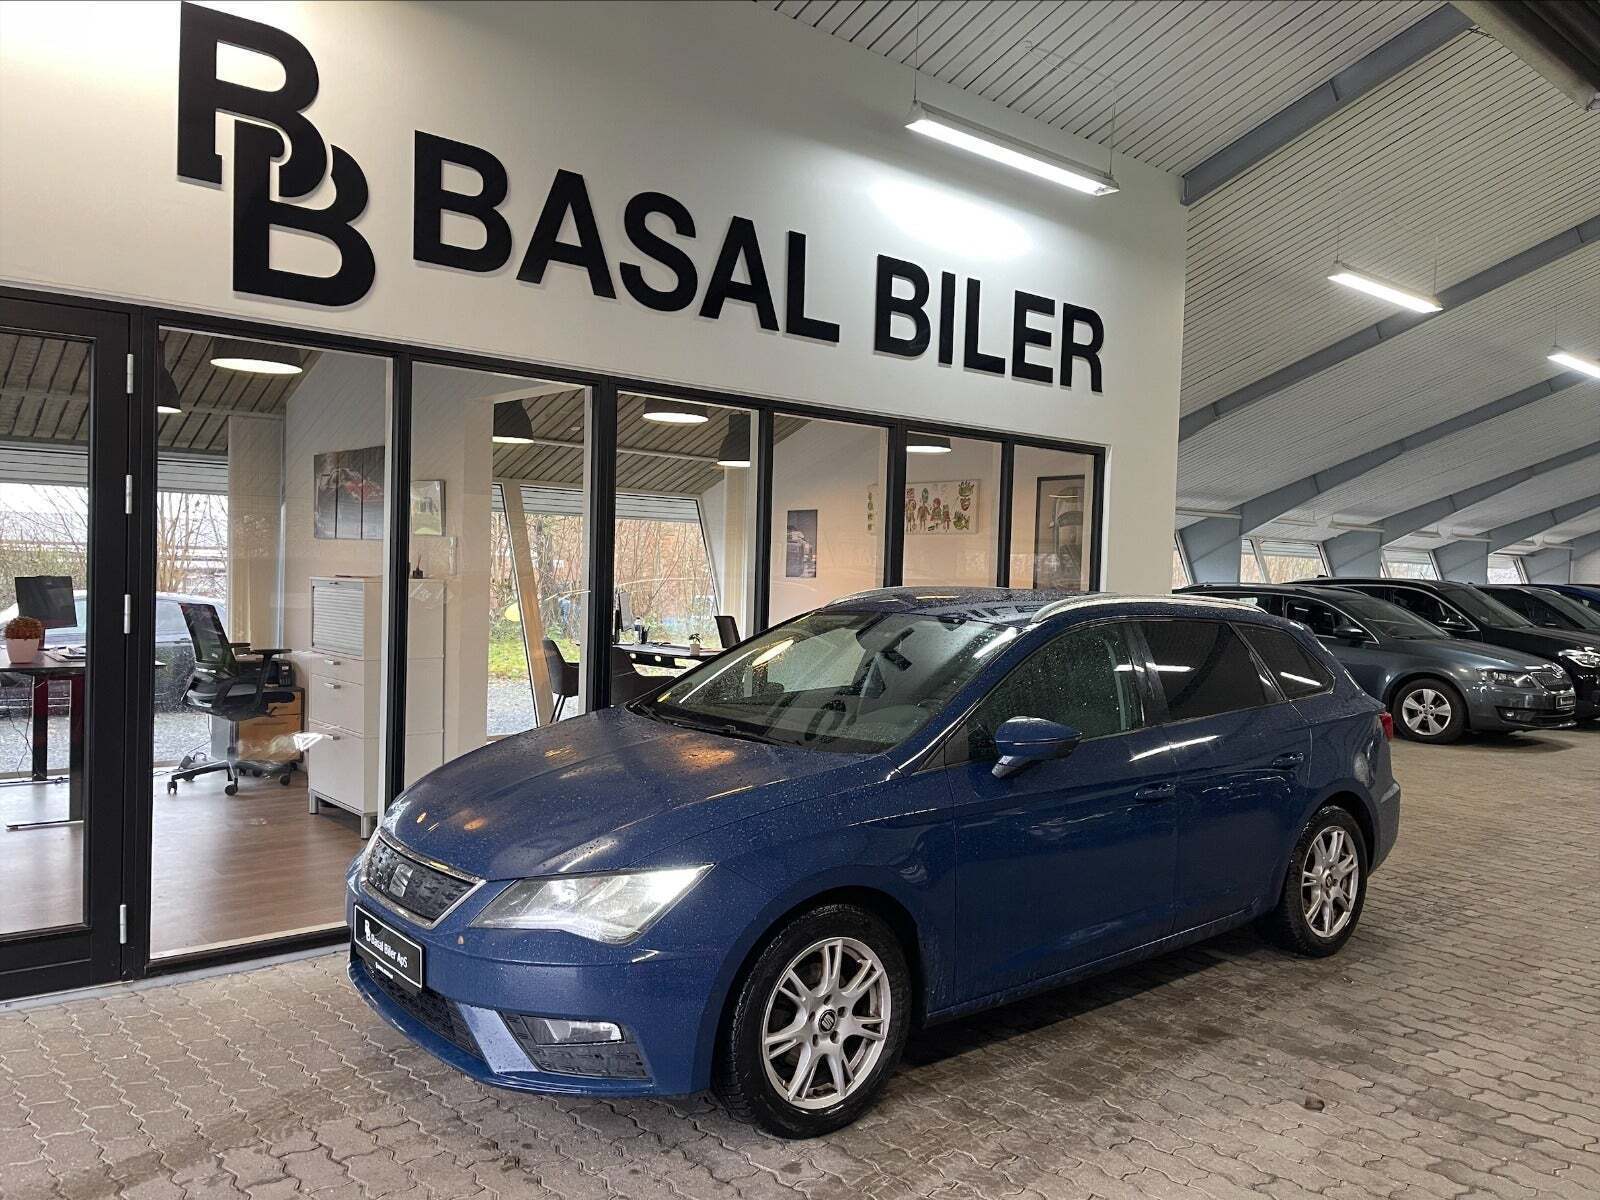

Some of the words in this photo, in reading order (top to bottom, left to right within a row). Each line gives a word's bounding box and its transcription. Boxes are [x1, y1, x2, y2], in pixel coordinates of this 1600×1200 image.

[413, 129, 840, 343] BASAL
[874, 254, 1105, 393] BILER
[384, 943, 397, 960] Biler
[397, 953, 408, 968] ApS
